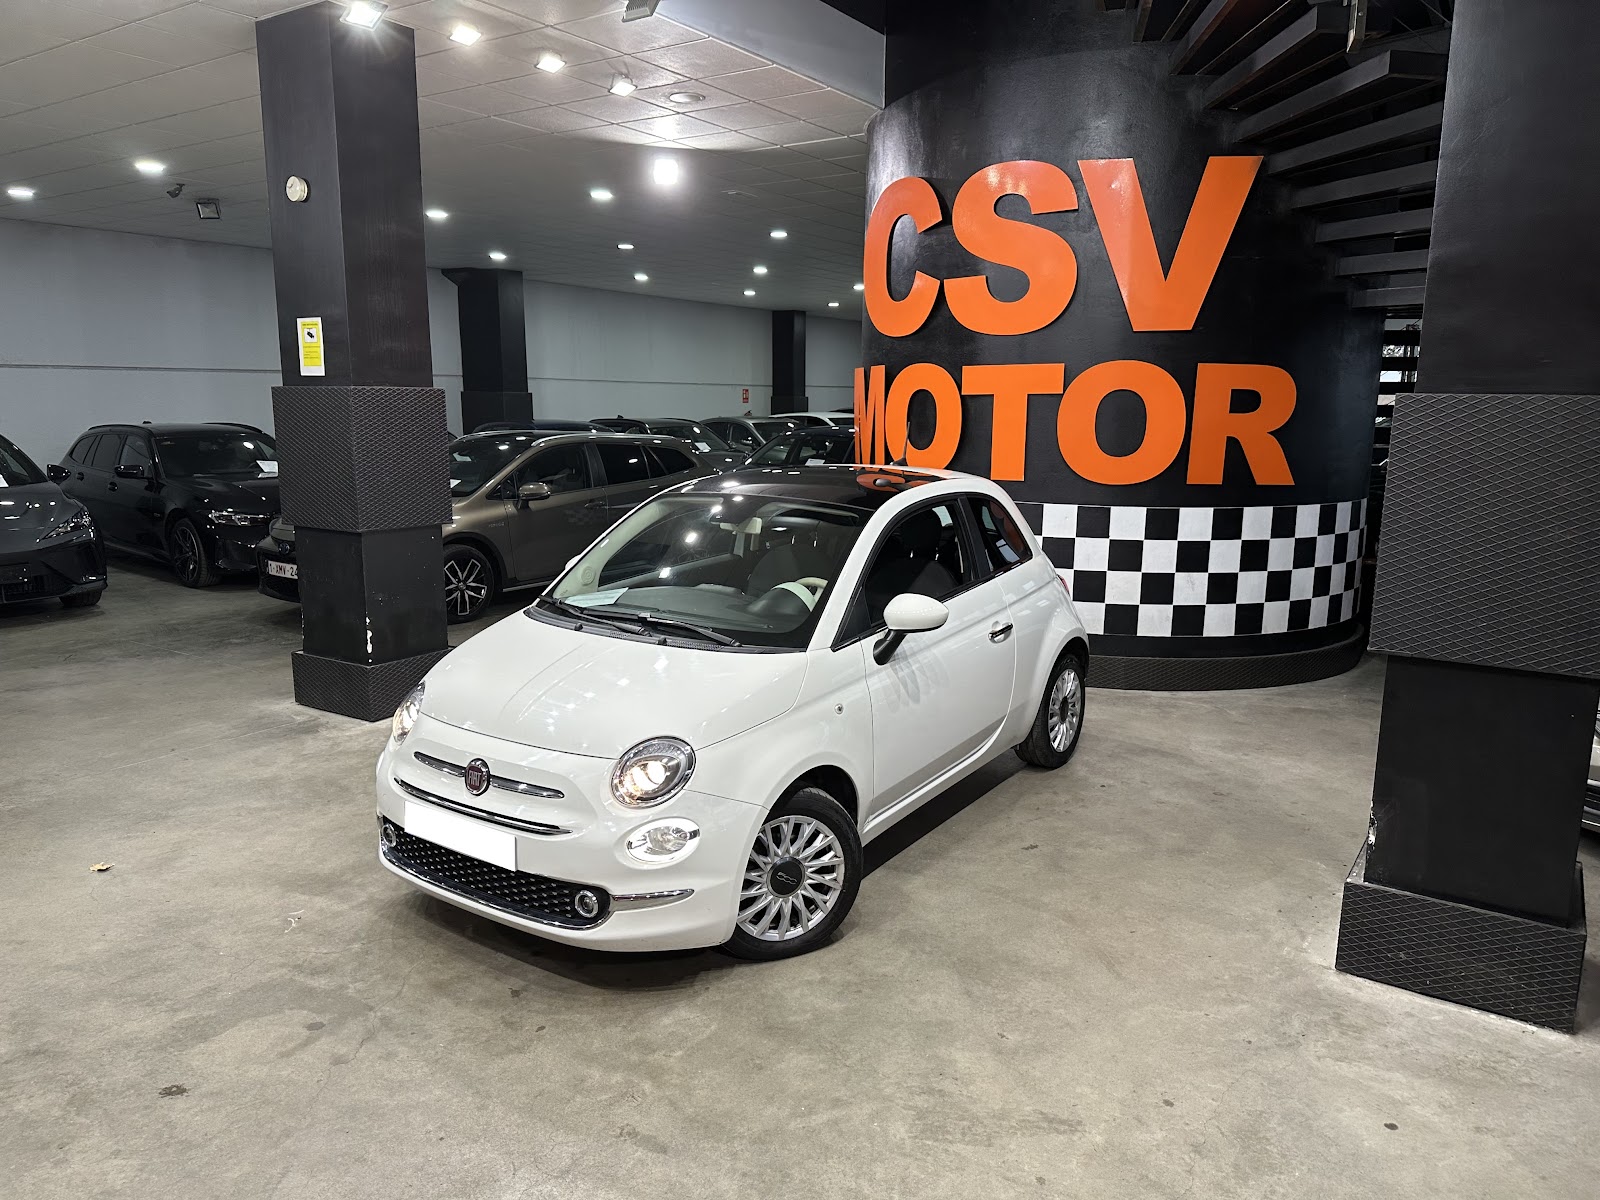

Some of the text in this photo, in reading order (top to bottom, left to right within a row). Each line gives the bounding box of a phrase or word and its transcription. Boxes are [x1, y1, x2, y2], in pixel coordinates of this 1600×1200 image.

[863, 156, 1264, 337] CSV
[854, 360, 1297, 485] MOTOR
[469, 770, 482, 787] FIAT
